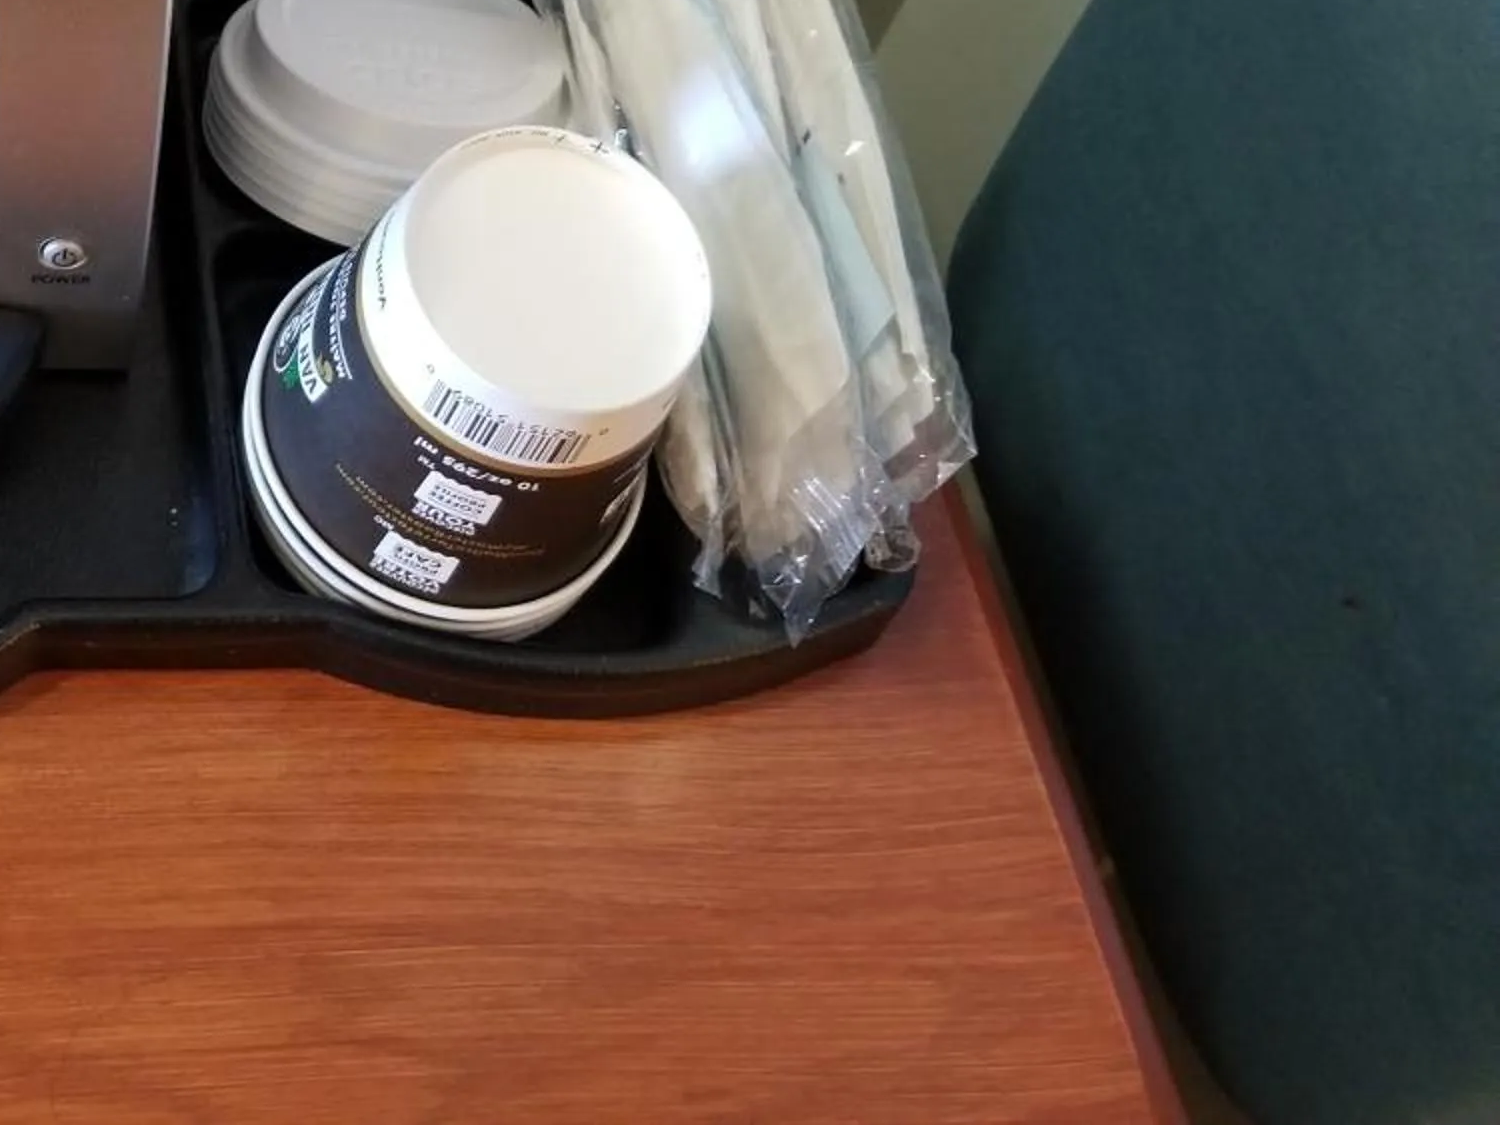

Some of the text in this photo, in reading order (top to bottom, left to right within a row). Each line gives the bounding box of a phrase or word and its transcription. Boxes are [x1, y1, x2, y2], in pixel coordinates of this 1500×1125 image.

[31, 274, 91, 284] POWER
[300, 342, 317, 393] VAN
[413, 436, 540, 492] 10 oz/295 ml
